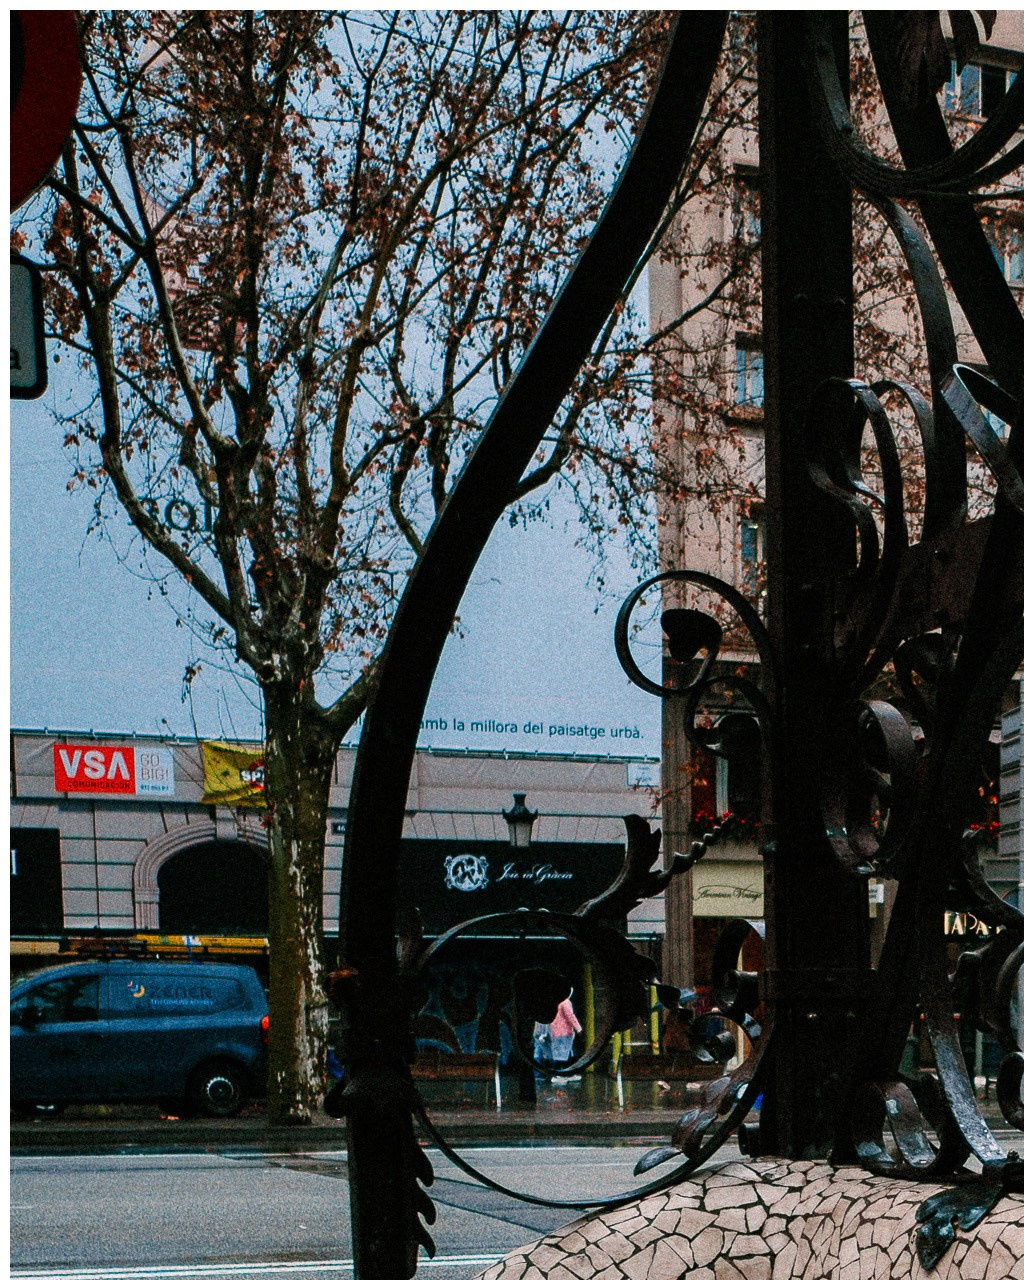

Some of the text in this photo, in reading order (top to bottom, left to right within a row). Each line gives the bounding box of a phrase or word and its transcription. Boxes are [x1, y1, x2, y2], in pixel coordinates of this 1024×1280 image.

[453, 718, 465, 731] la
[470, 720, 518, 733] millora
[523, 721, 544, 735] del
[548, 723, 605, 740] paisatge
[610, 725, 644, 739] urbà.
[59, 749, 131, 780] VSA
[141, 753, 160, 767] GO
[141, 767, 169, 780] BIG!
